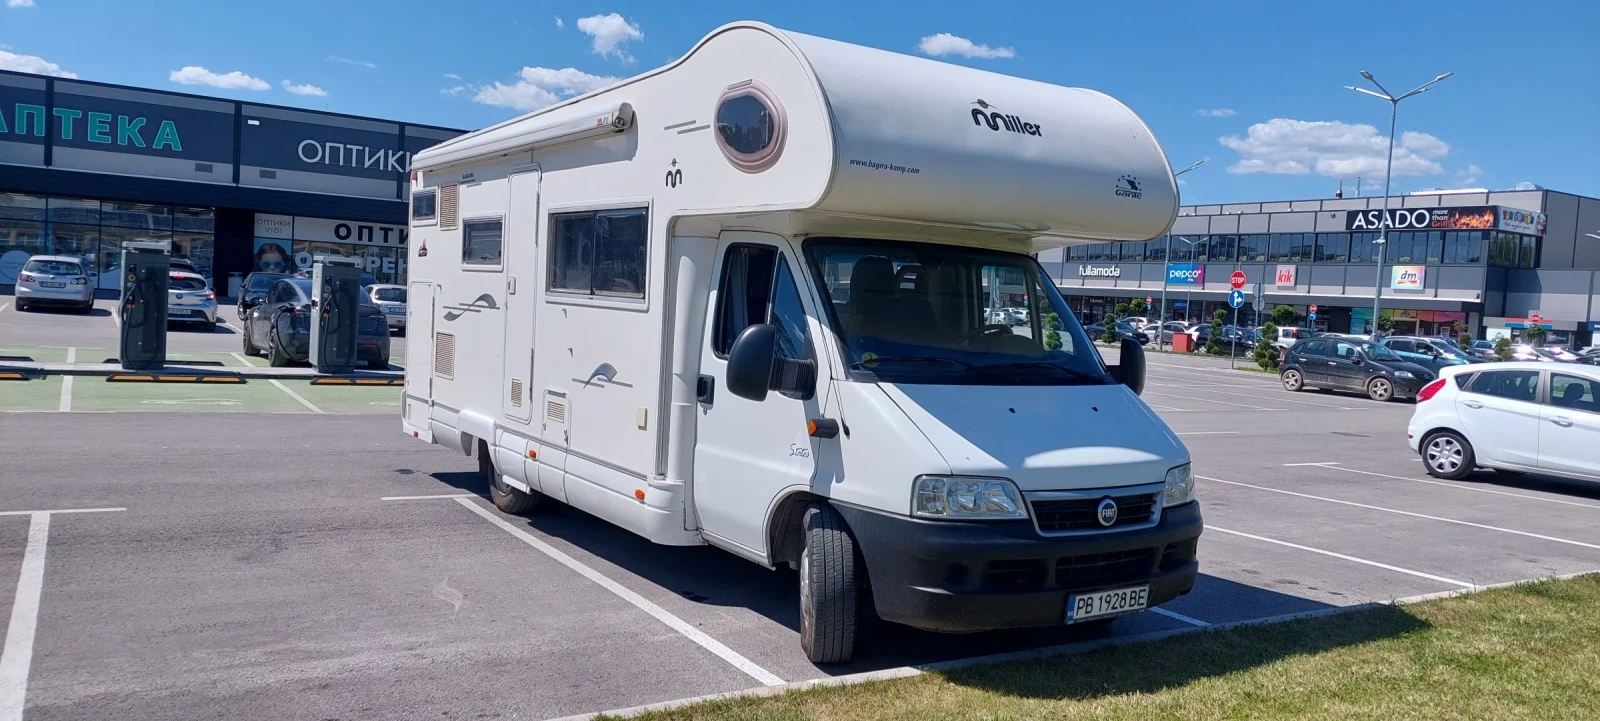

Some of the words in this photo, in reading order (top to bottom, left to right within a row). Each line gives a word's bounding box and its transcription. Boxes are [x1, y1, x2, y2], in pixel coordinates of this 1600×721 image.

[0, 103, 182, 151] ПТЕКА
[971, 107, 1043, 137] Miller
[849, 158, 920, 175] www.bagira-kemp.com
[1352, 209, 1430, 229] ASADO
[1079, 264, 1121, 278] fullamoda
[1169, 269, 1199, 280] pepco
[1400, 270, 1417, 280] dm
[1231, 276, 1245, 284] STOP
[1102, 508, 1115, 518] FIAT
[1076, 596, 1094, 616] PB
[1099, 592, 1127, 612] 1928
[1129, 589, 1146, 607] BE
